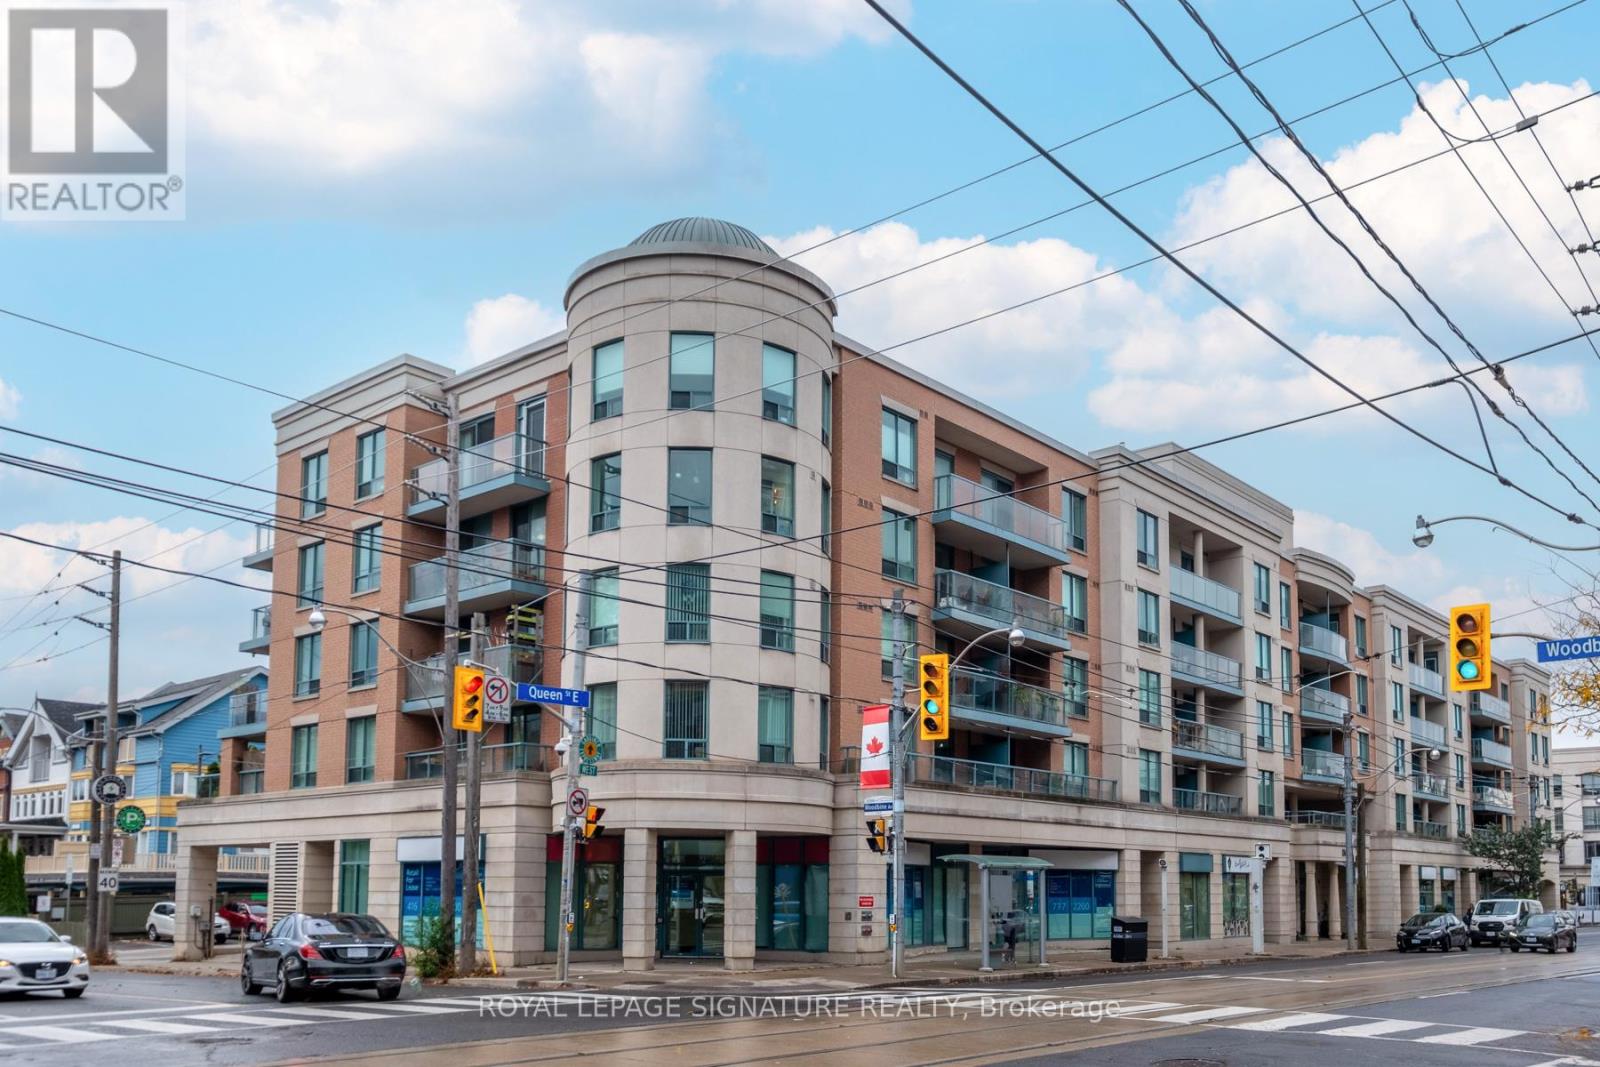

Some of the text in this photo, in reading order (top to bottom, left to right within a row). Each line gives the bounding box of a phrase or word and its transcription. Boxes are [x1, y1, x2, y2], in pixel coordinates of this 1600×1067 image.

[1546, 638, 1600, 657] Woodb
[528, 686, 563, 701] Queen
[572, 691, 579, 703] E
[127, 812, 138, 824] P
[100, 877, 117, 889] 40
